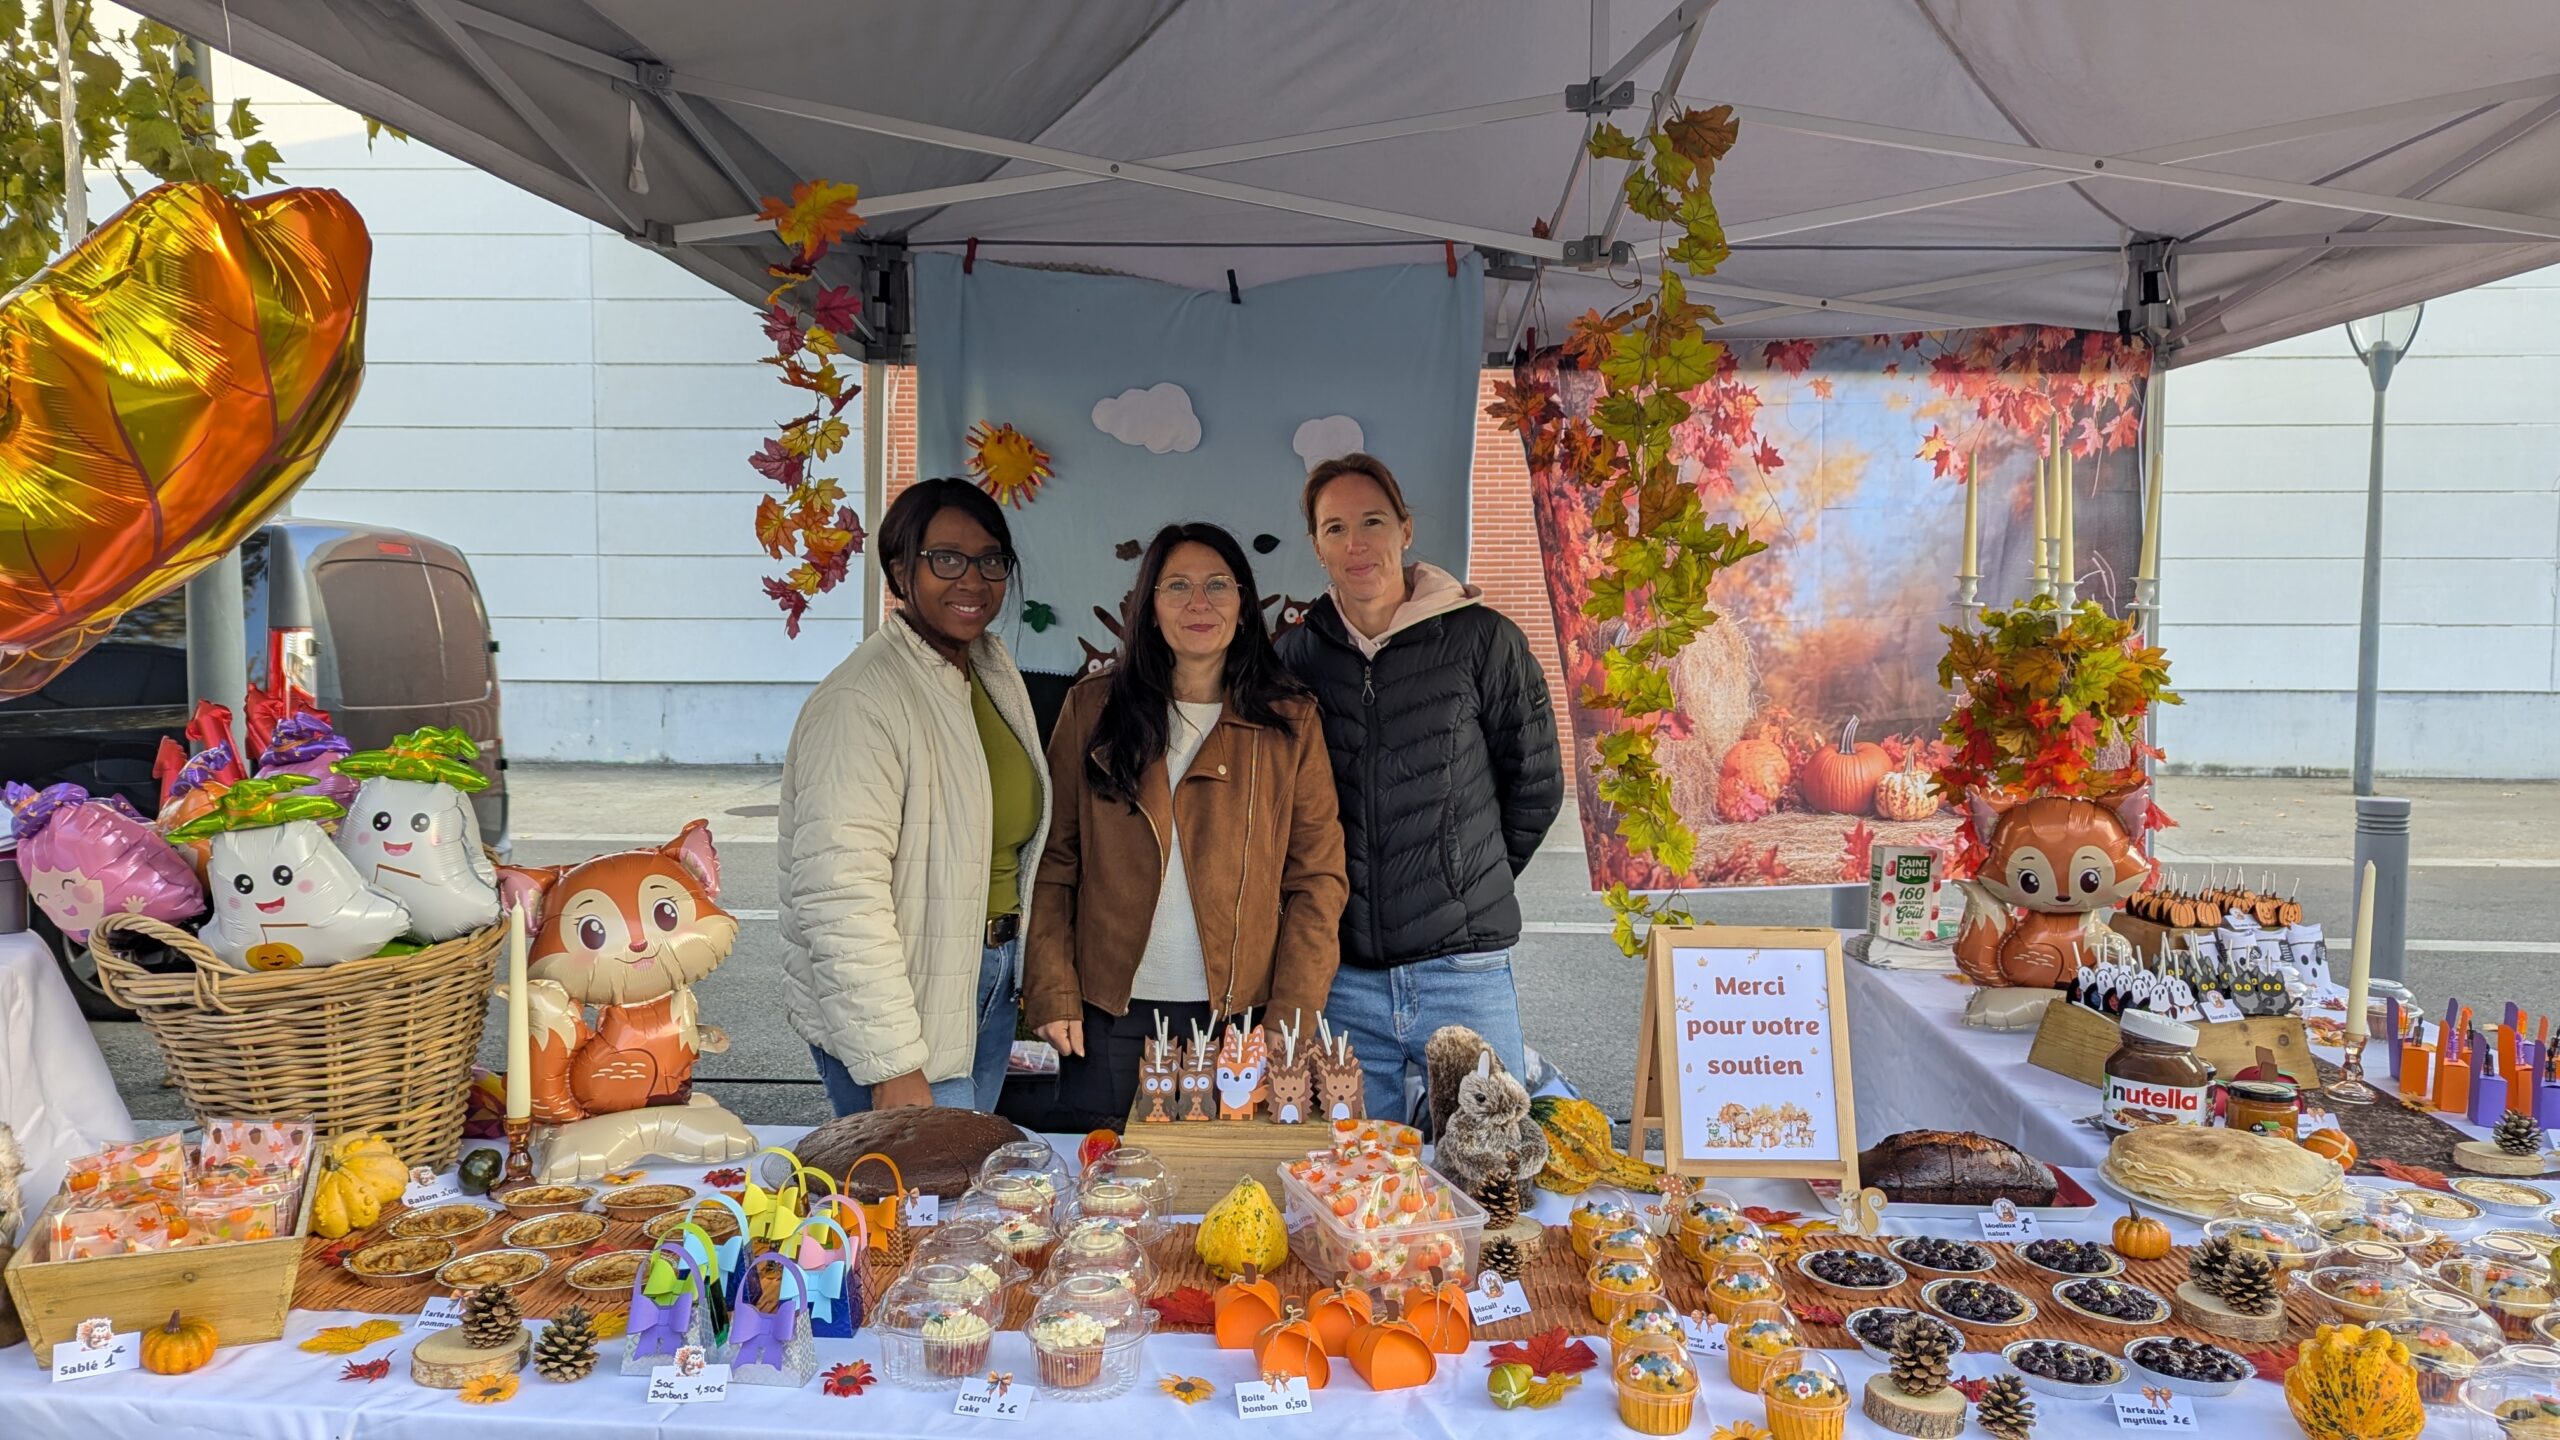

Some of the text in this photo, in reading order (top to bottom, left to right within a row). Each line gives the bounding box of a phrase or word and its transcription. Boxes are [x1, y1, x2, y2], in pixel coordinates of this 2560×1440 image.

[1898, 858, 1928, 868] SAINT
[1899, 868, 1928, 879] LOUIS
[1898, 887, 1925, 900] 160
[1896, 905, 1925, 923] Goût
[1715, 976, 1786, 996] Merci
[1687, 1017, 1820, 1041] pour votre
[1707, 1055, 1804, 1075] soutien
[2112, 1084, 2198, 1110] nutella
[407, 1193, 438, 1205] Ballon
[1474, 1302, 1498, 1314] biscuit
[424, 1310, 444, 1318] Tarte
[1478, 1314, 1493, 1322] lune
[60, 1360, 98, 1376] Sablé
[654, 1379, 675, 1389] Sac
[962, 1393, 991, 1404] Carrot
[959, 1404, 980, 1414] cake
[1243, 1403, 1278, 1413] bonbon
[2120, 1405, 2165, 1415] Tarte aux
[2123, 1416, 2168, 1426] myrtilles
